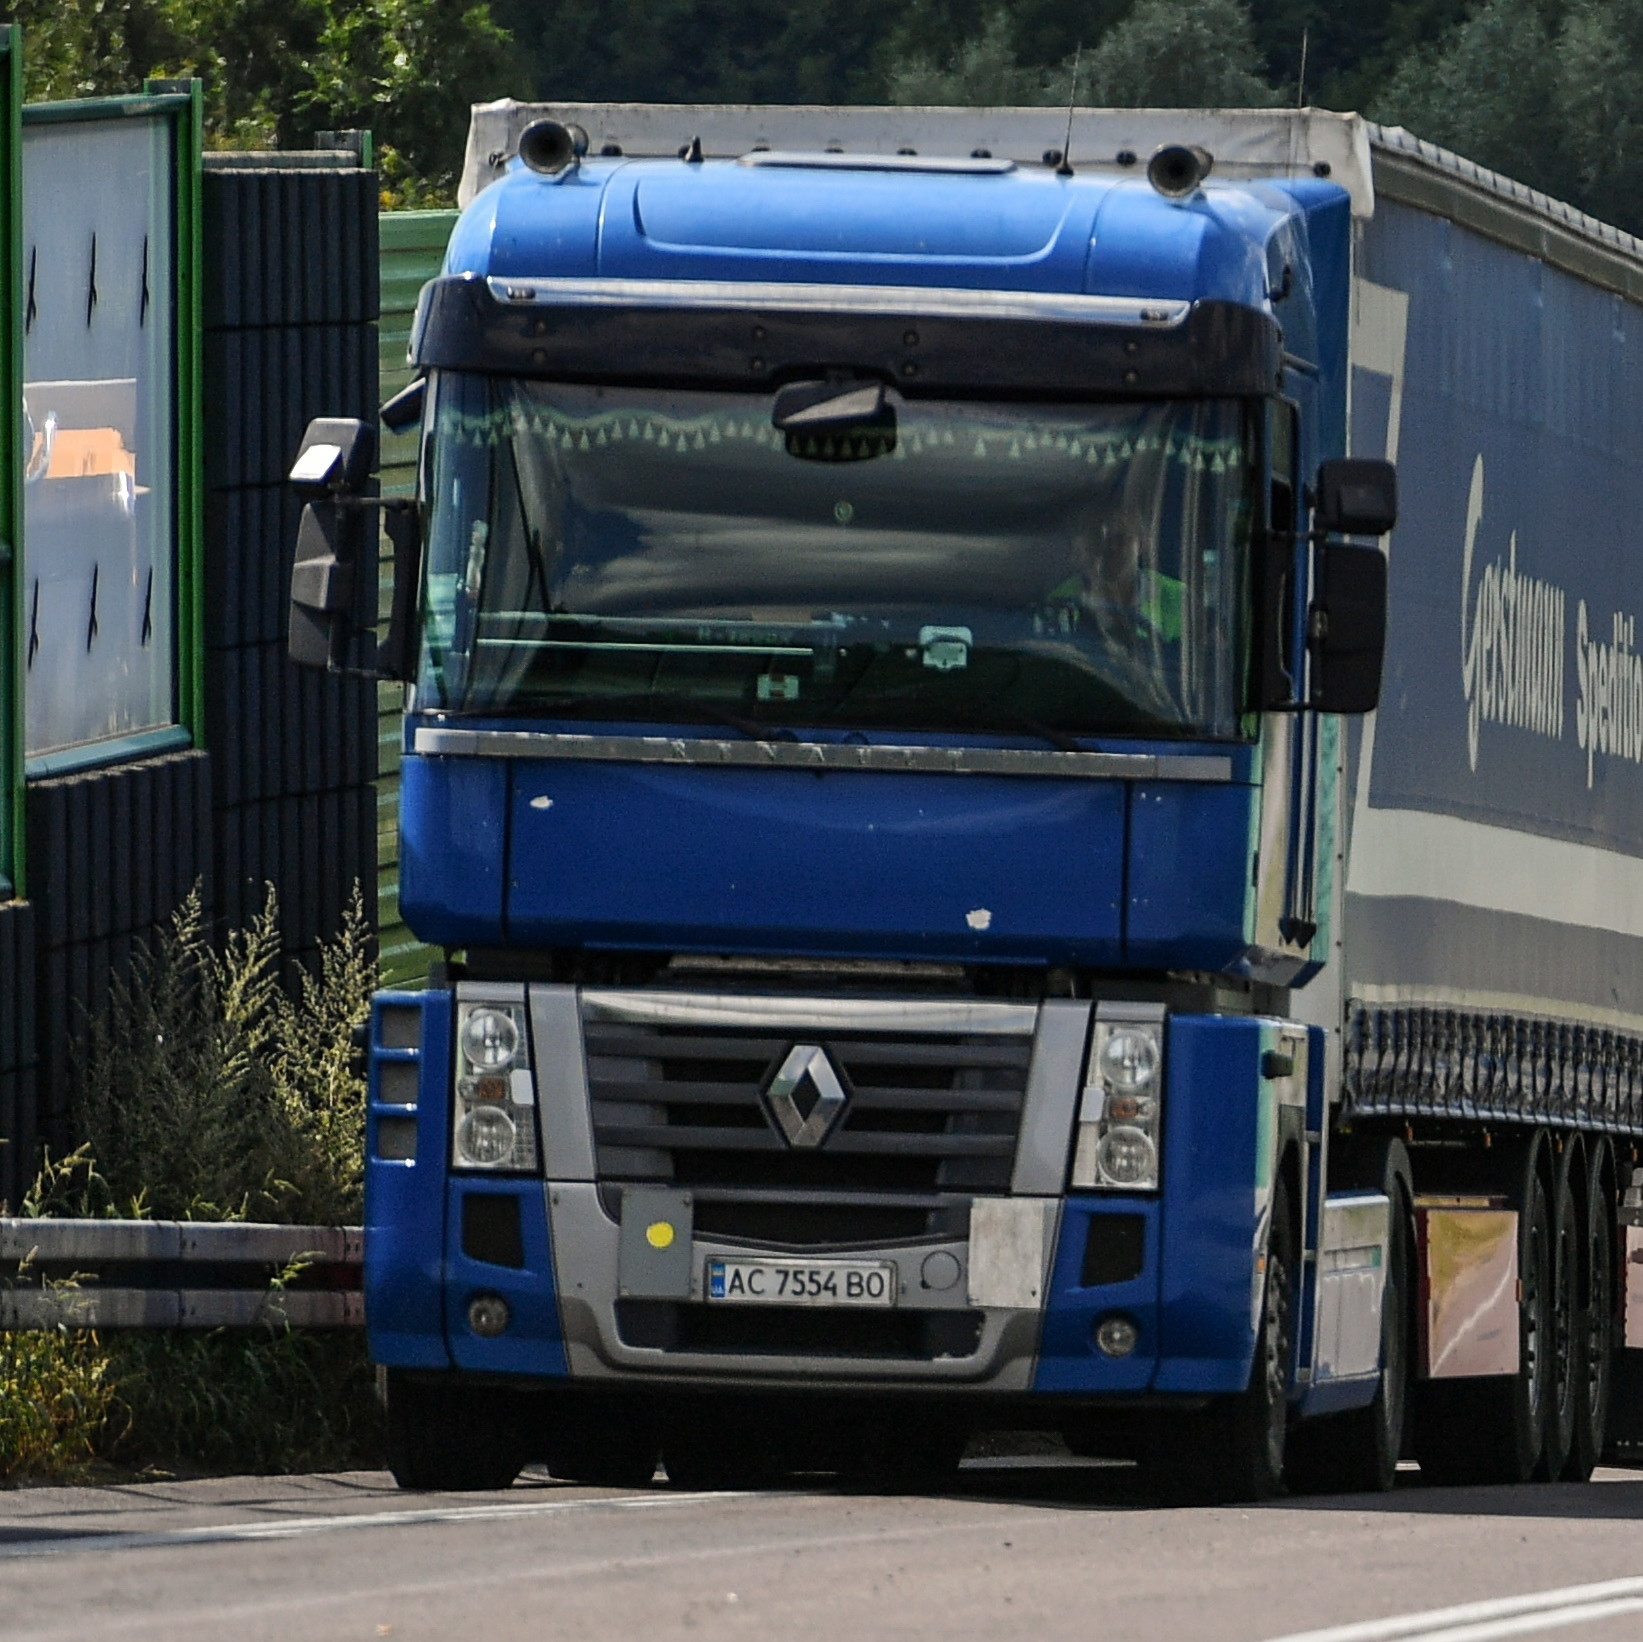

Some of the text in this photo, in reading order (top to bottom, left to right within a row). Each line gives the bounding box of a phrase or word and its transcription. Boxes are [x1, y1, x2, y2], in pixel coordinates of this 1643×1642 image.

[728, 1268, 885, 1298] AC 7554 BO
